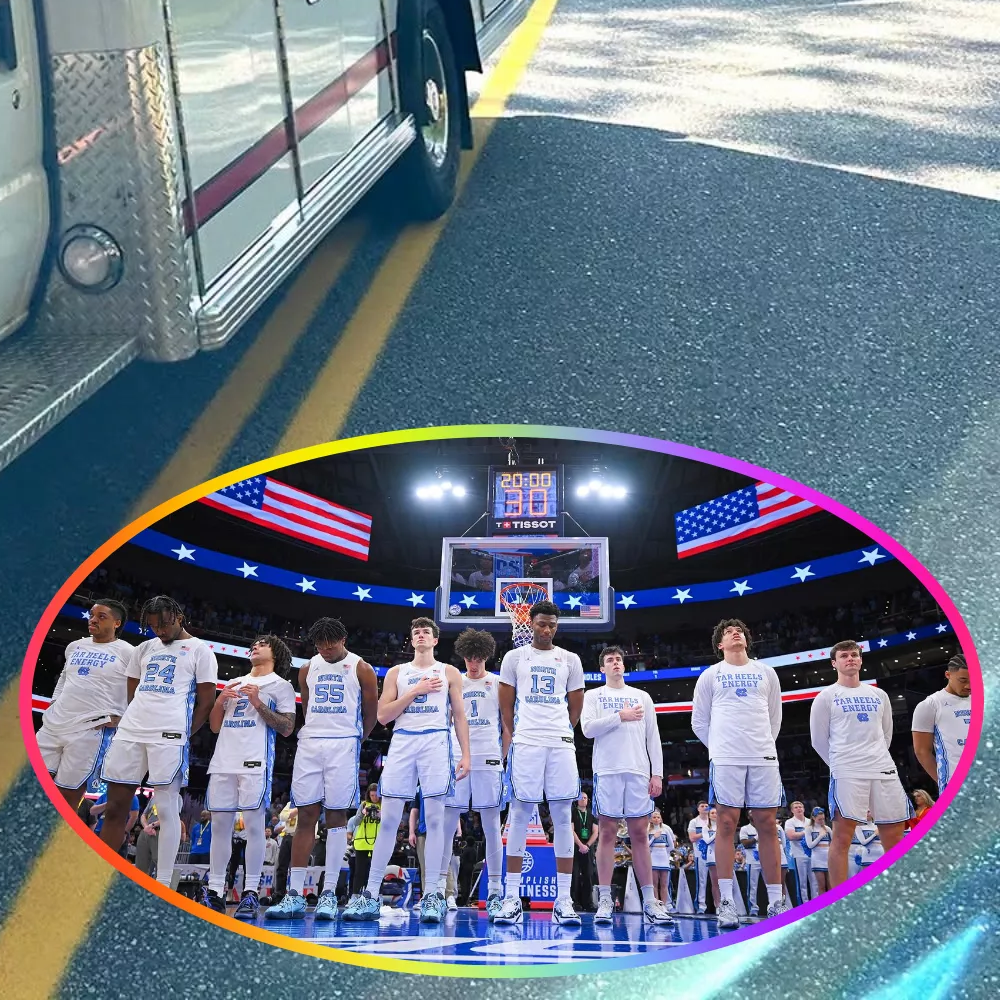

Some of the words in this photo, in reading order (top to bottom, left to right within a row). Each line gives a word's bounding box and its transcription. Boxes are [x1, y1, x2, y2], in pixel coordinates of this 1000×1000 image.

[501, 473, 551, 488] 20:00
[505, 489, 547, 516] 30
[514, 520, 556, 529] TISSOT
[70, 658, 107, 668] ENERGY
[86, 652, 116, 662] HEELS
[144, 663, 176, 684] 24
[716, 674, 733, 682] TAR
[531, 675, 555, 694] 13
[315, 684, 344, 703] 55
[233, 699, 250, 717] 2
[471, 700, 478, 717] 1
[834, 698, 852, 706] TAR
[520, 885, 557, 897] TNESS
